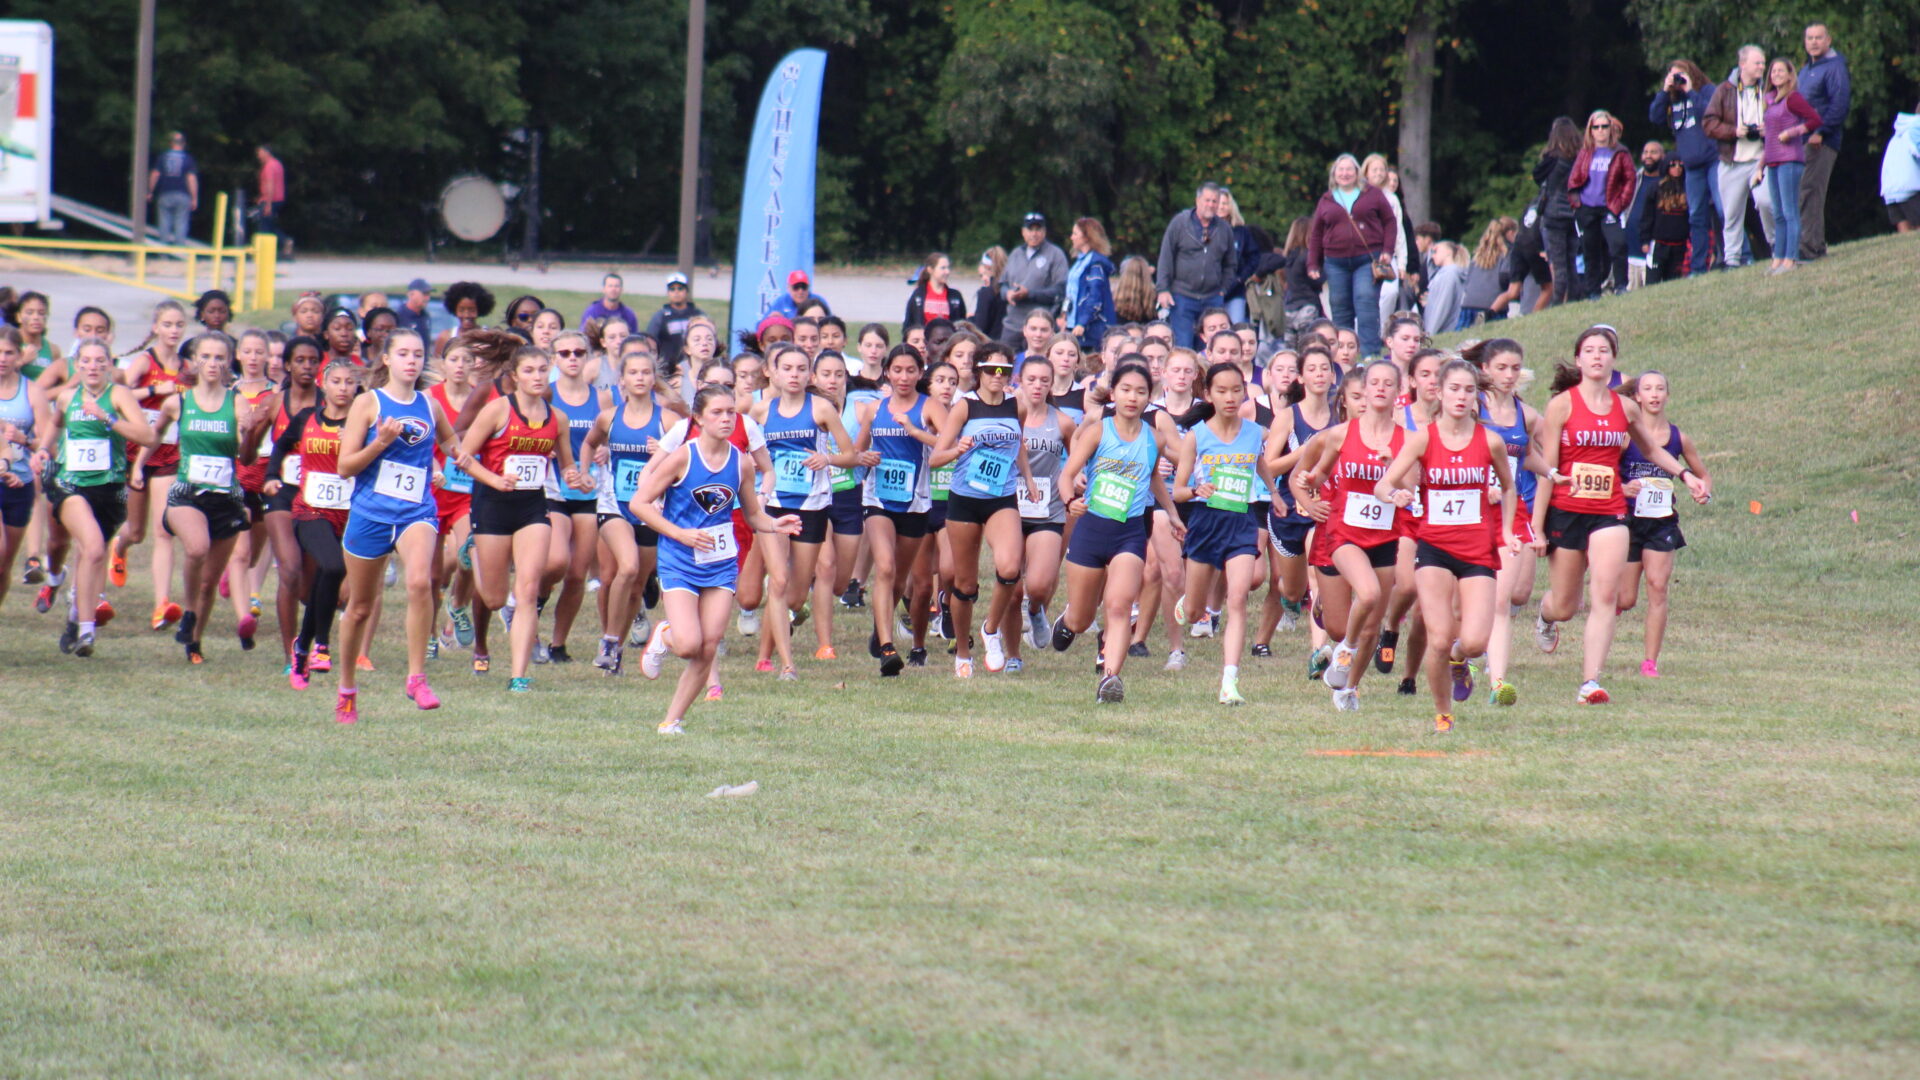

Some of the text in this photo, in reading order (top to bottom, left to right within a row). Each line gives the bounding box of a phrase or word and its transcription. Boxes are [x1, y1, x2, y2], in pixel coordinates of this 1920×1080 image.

[188, 419, 229, 433] ARUNDEL
[509, 436, 554, 452] CROFTON
[78, 448, 97, 463] 78
[1202, 453, 1256, 465] RIVER
[202, 464, 224, 479] 77
[516, 465, 538, 482] 257
[784, 459, 805, 477] 492
[979, 459, 1002, 478] 460
[1429, 466, 1485, 485] SPALDING
[394, 473, 416, 491] 13
[884, 469, 906, 485] 499
[1217, 475, 1248, 494] 1646
[1576, 474, 1611, 492] 1996
[316, 483, 342, 501] 261
[1019, 489, 1044, 501] 120
[1099, 481, 1130, 504] 1643
[1647, 491, 1664, 504] 709
[1360, 504, 1382, 521] 49
[1442, 499, 1466, 516] 47
